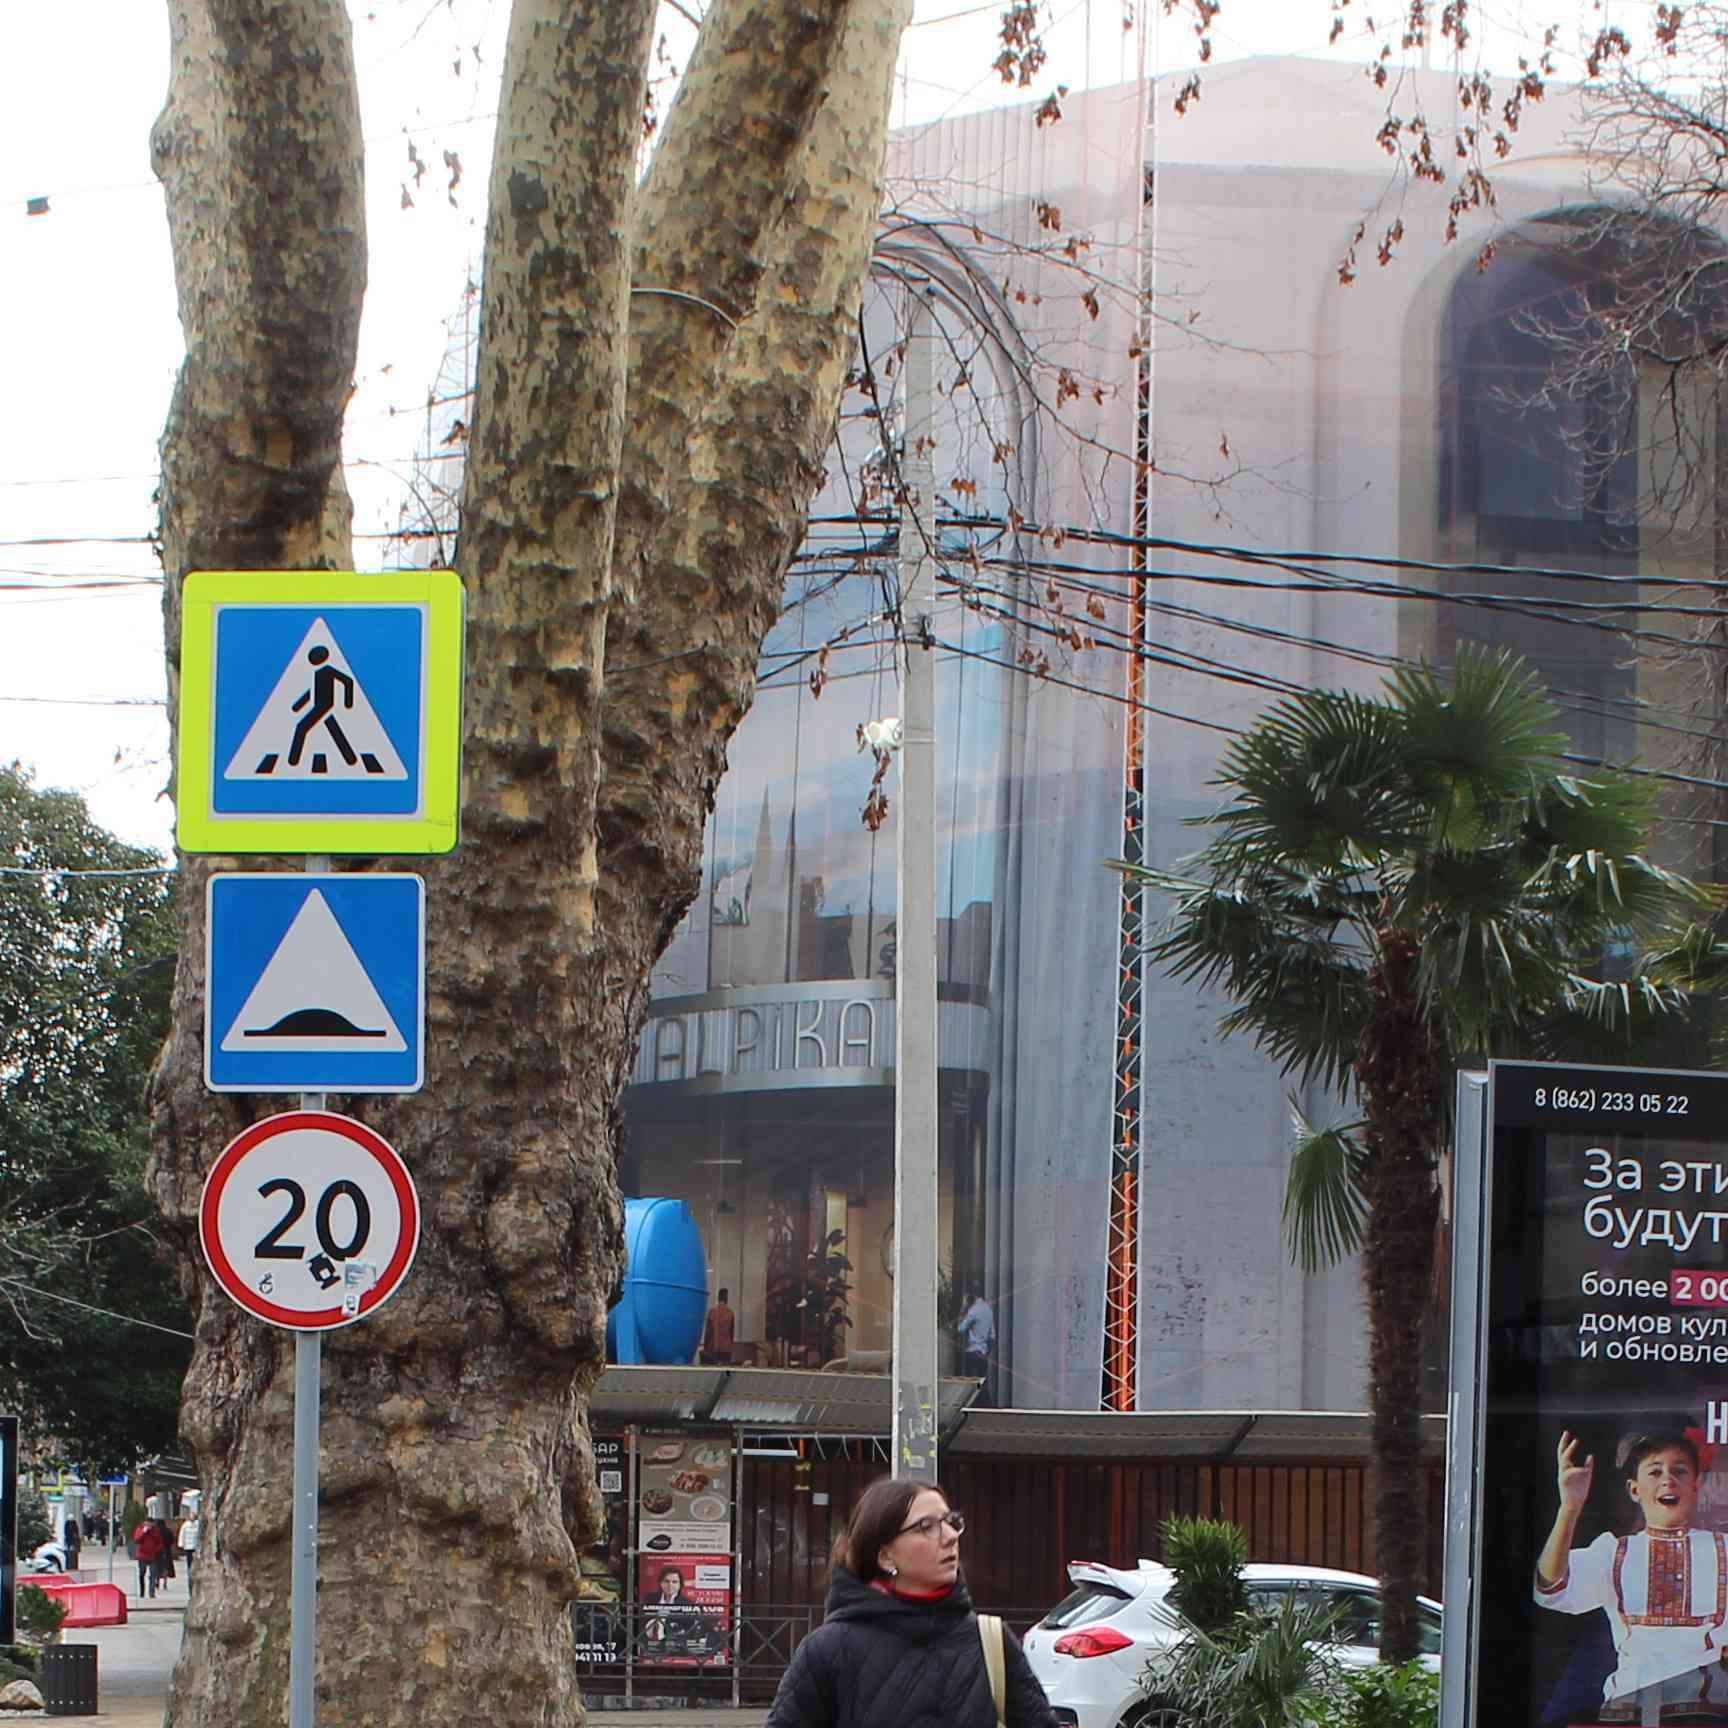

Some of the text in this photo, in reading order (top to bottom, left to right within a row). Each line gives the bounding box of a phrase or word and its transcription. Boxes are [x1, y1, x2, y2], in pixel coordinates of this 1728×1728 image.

[1534, 1088, 1689, 1115] 8 (862) 233 05 22
[1584, 1147, 1642, 1192] За
[254, 1178, 371, 1261] 20
[1583, 1193, 1728, 1252] будут
[1580, 1270, 1668, 1300] более
[1675, 1275, 1693, 1300] 2
[1579, 1312, 1671, 1337] домов
[1580, 1339, 1598, 1360] и
